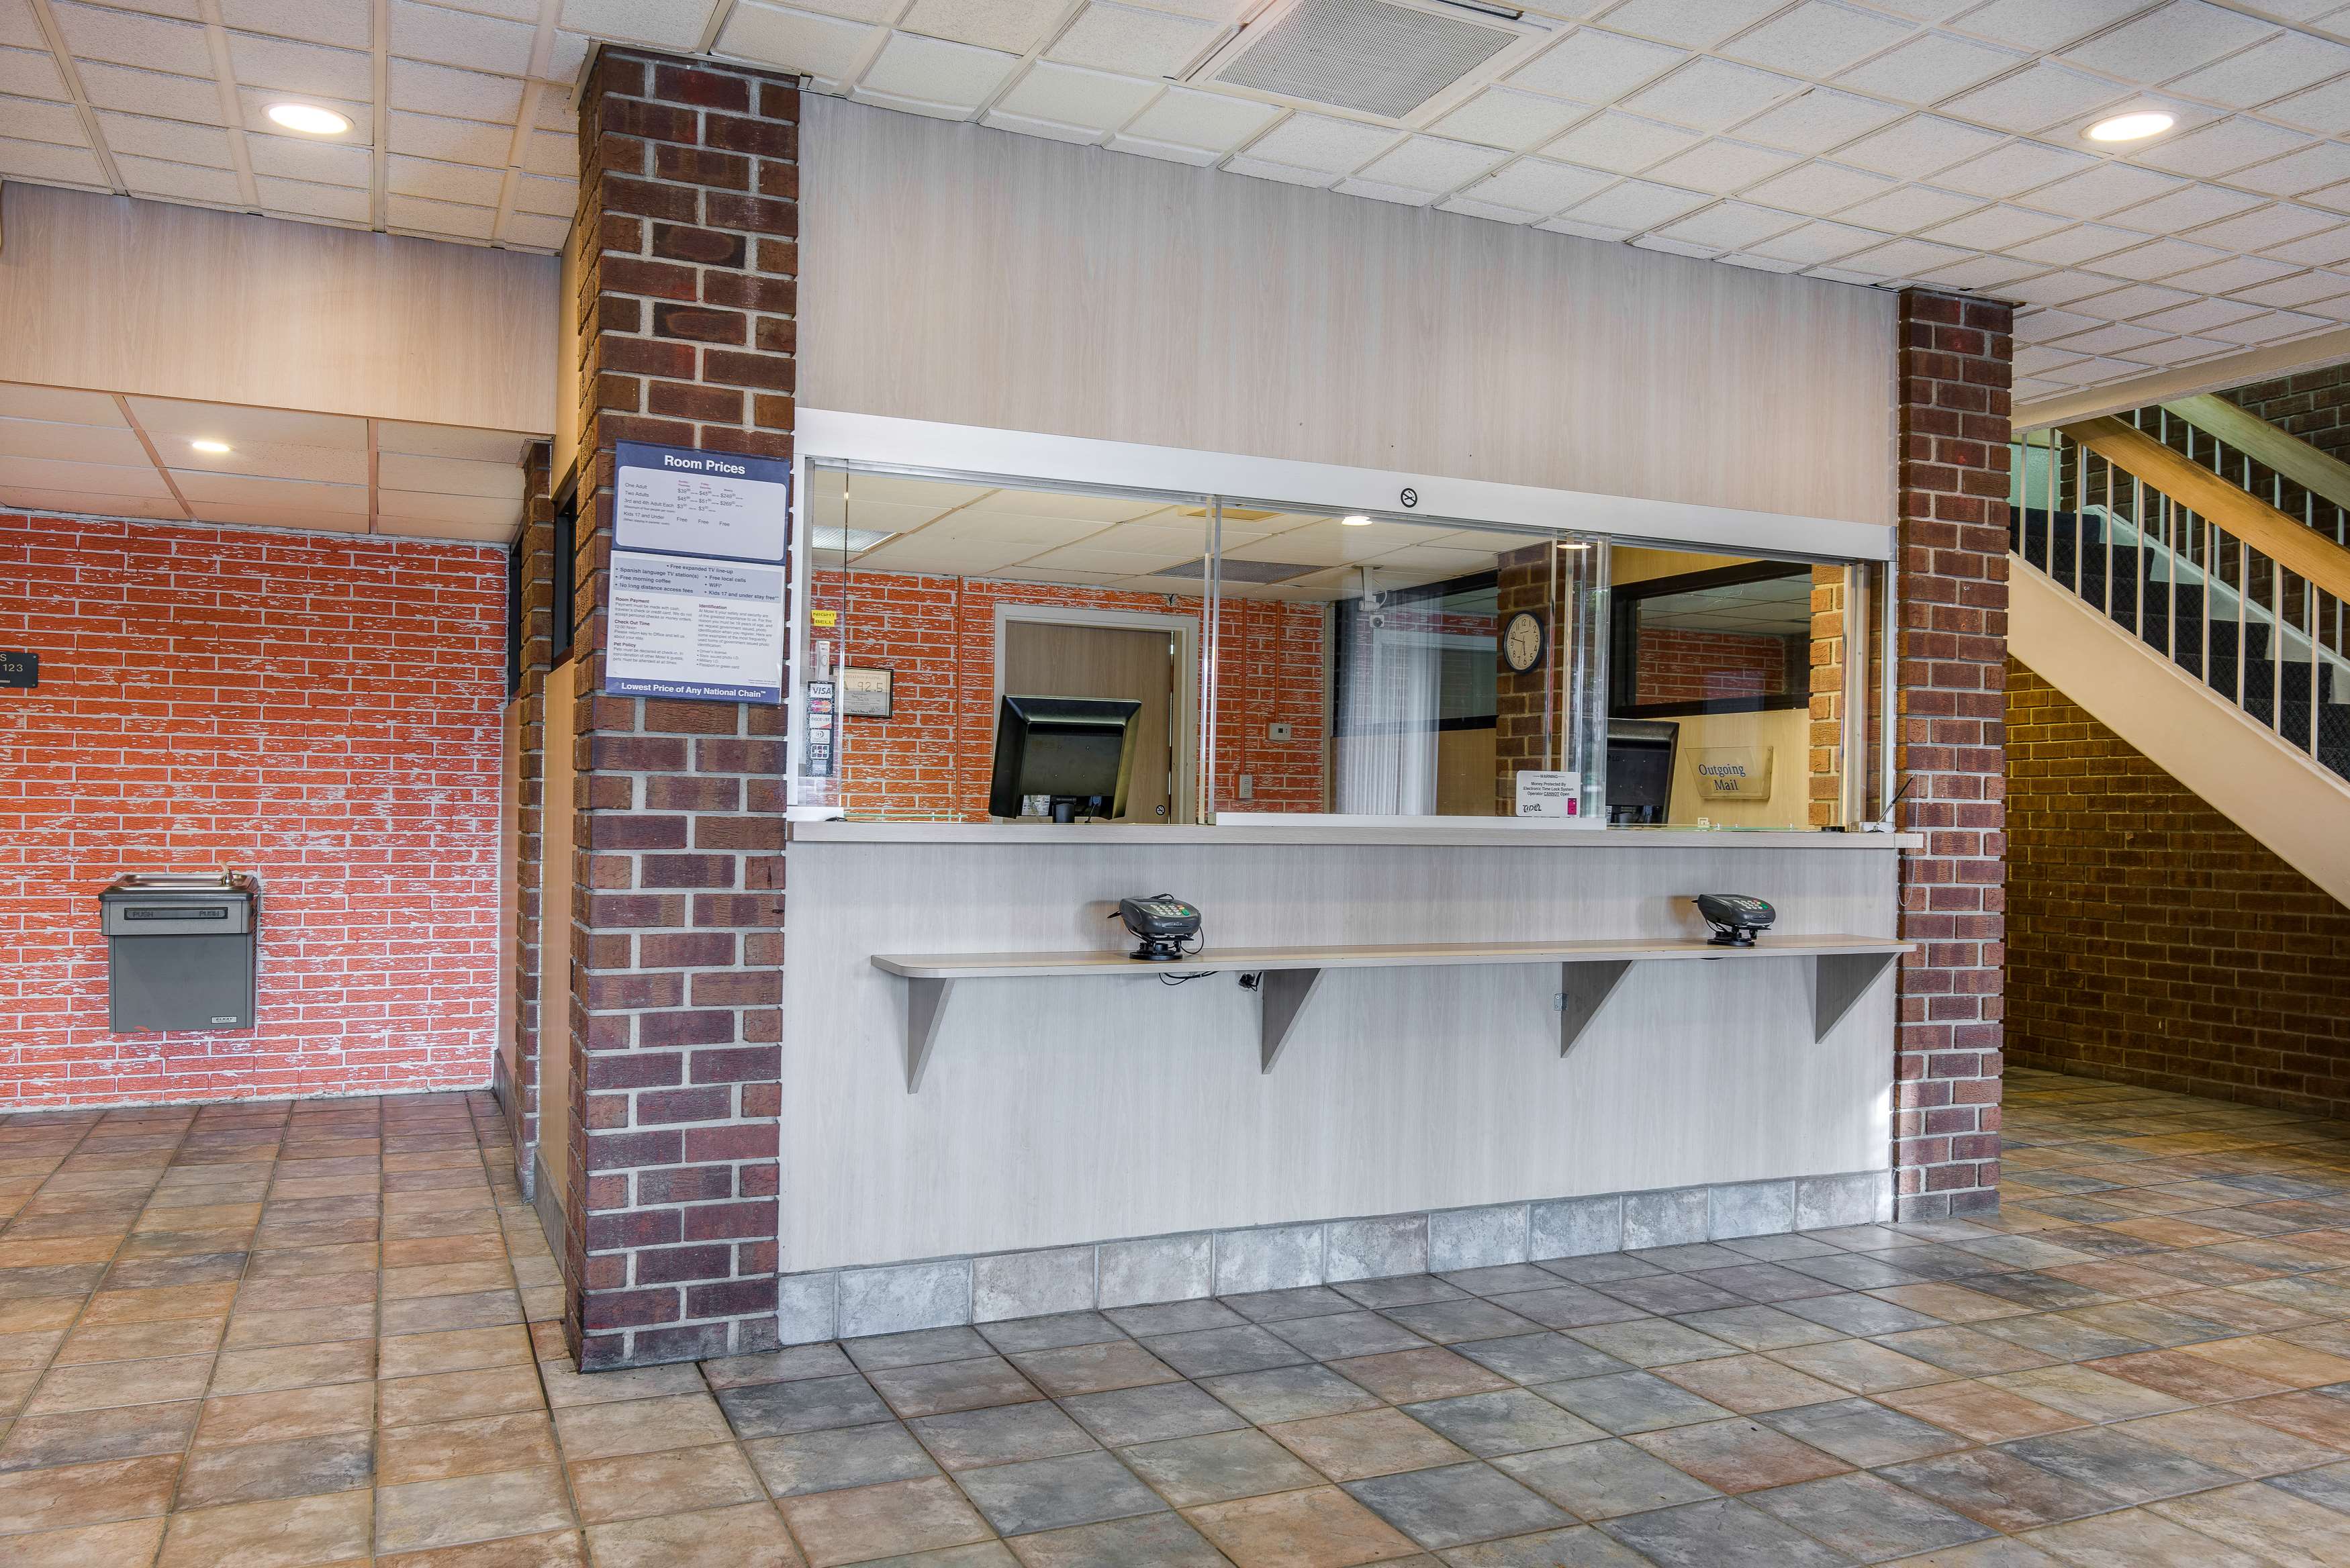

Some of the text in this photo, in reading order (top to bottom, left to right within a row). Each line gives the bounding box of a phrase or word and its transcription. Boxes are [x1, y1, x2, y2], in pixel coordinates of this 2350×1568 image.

[664, 455, 745, 474] Room Prices
[621, 682, 651, 690] Lowest
[653, 684, 674, 692] Price
[686, 686, 701, 695] Any
[703, 687, 736, 696] National
[1698, 764, 1746, 777] Outgoing
[1713, 779, 1739, 790] Mail
